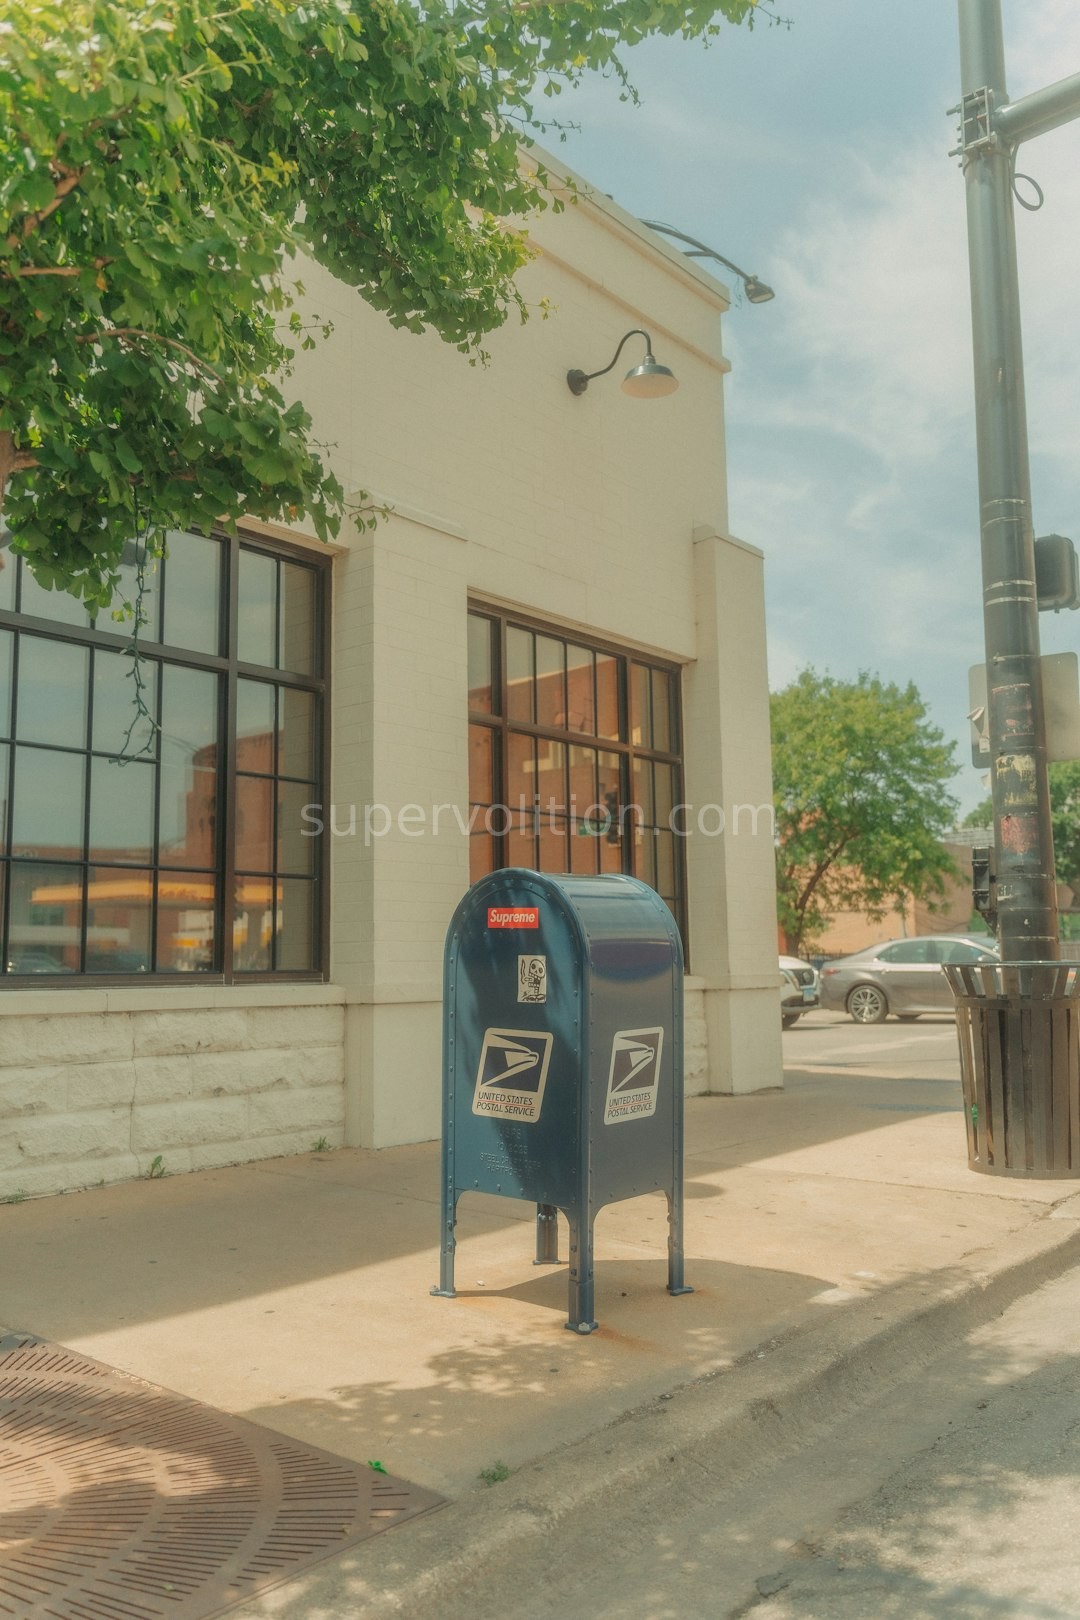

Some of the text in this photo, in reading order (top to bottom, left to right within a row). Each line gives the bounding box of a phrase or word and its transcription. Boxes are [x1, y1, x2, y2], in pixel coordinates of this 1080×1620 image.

[490, 909, 536, 927] Supreme
[478, 1091, 533, 1106] UNITED STATES
[609, 1092, 651, 1107] UNITED STATES
[476, 1101, 536, 1117] POSTAL SERVICE
[607, 1102, 653, 1119] POSTAL SERVICE
